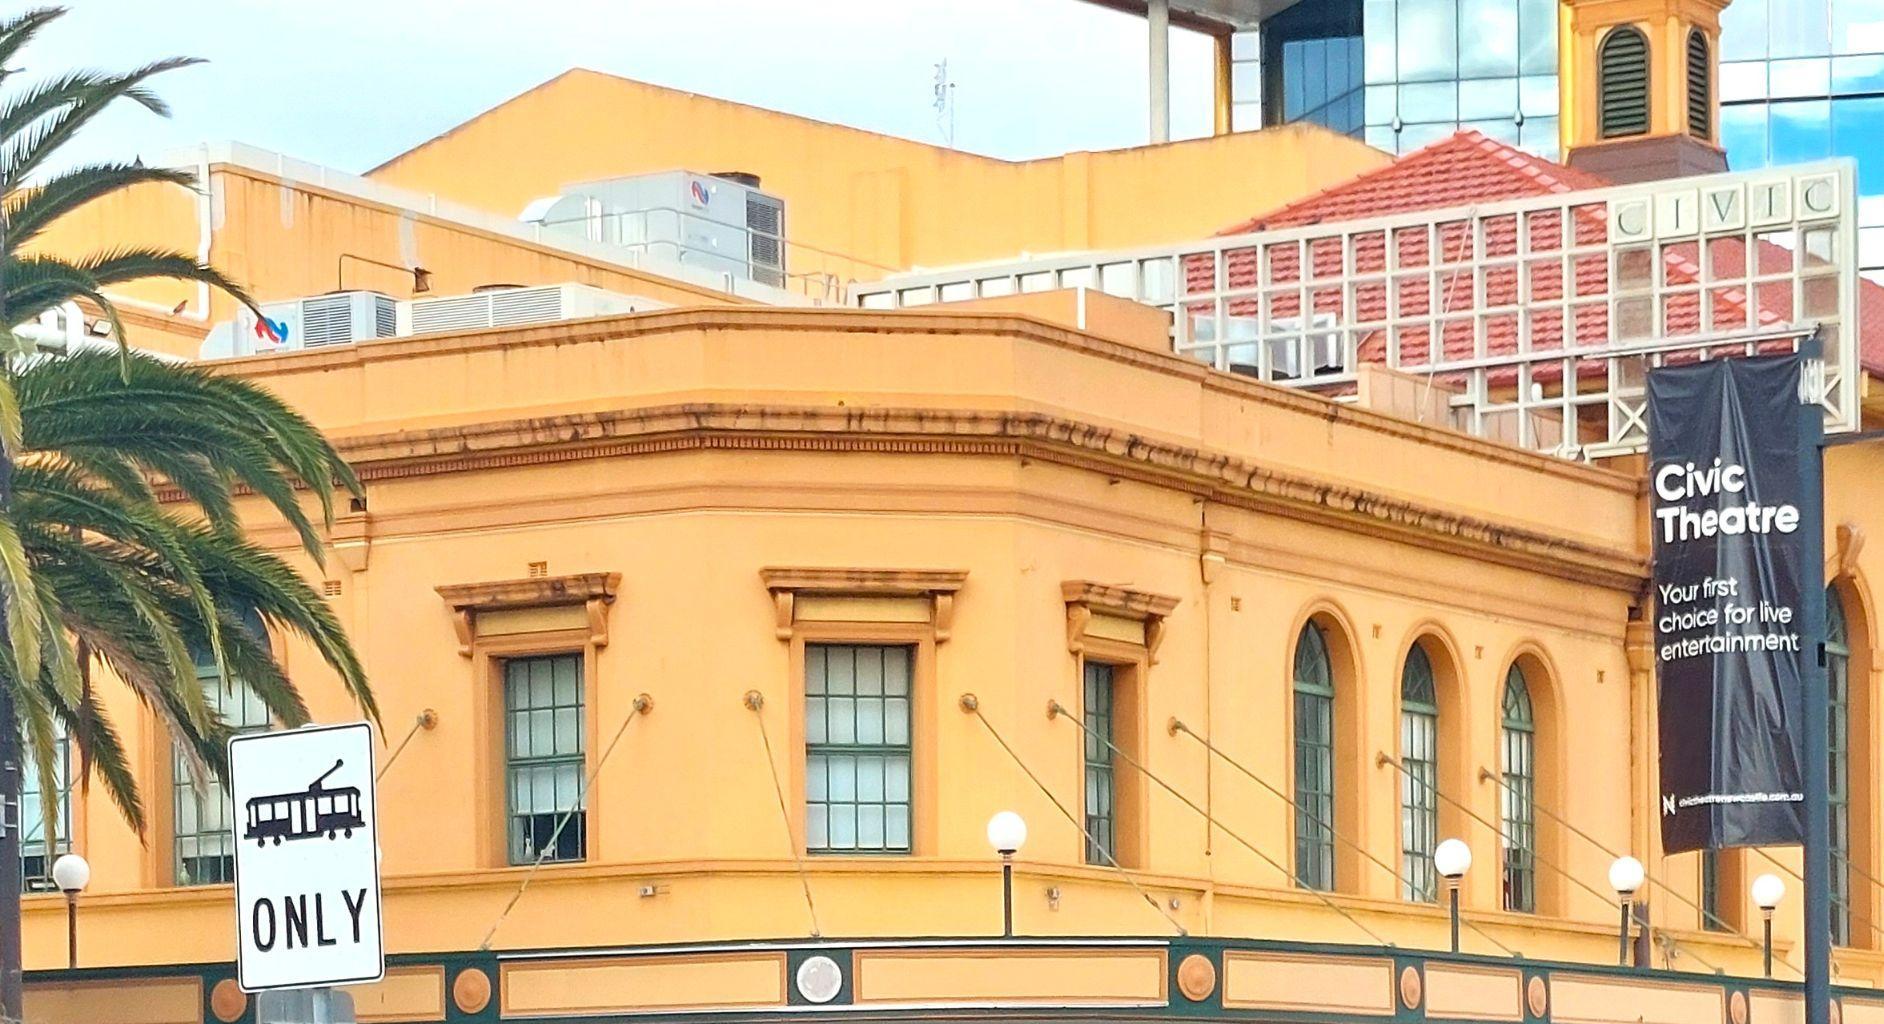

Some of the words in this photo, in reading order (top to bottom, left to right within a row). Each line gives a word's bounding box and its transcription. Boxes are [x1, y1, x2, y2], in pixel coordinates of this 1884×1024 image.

[1617, 180, 1832, 236] CIVIC
[1655, 457, 1746, 501] Civic
[1656, 502, 1800, 543] Theatre
[1659, 581, 1699, 605] Your
[1702, 576, 1738, 599] first
[1659, 606, 1718, 633] choice
[1724, 602, 1755, 624] for
[1759, 600, 1792, 624] live
[1661, 631, 1800, 661] entertainment
[253, 888, 367, 952] ONLY
